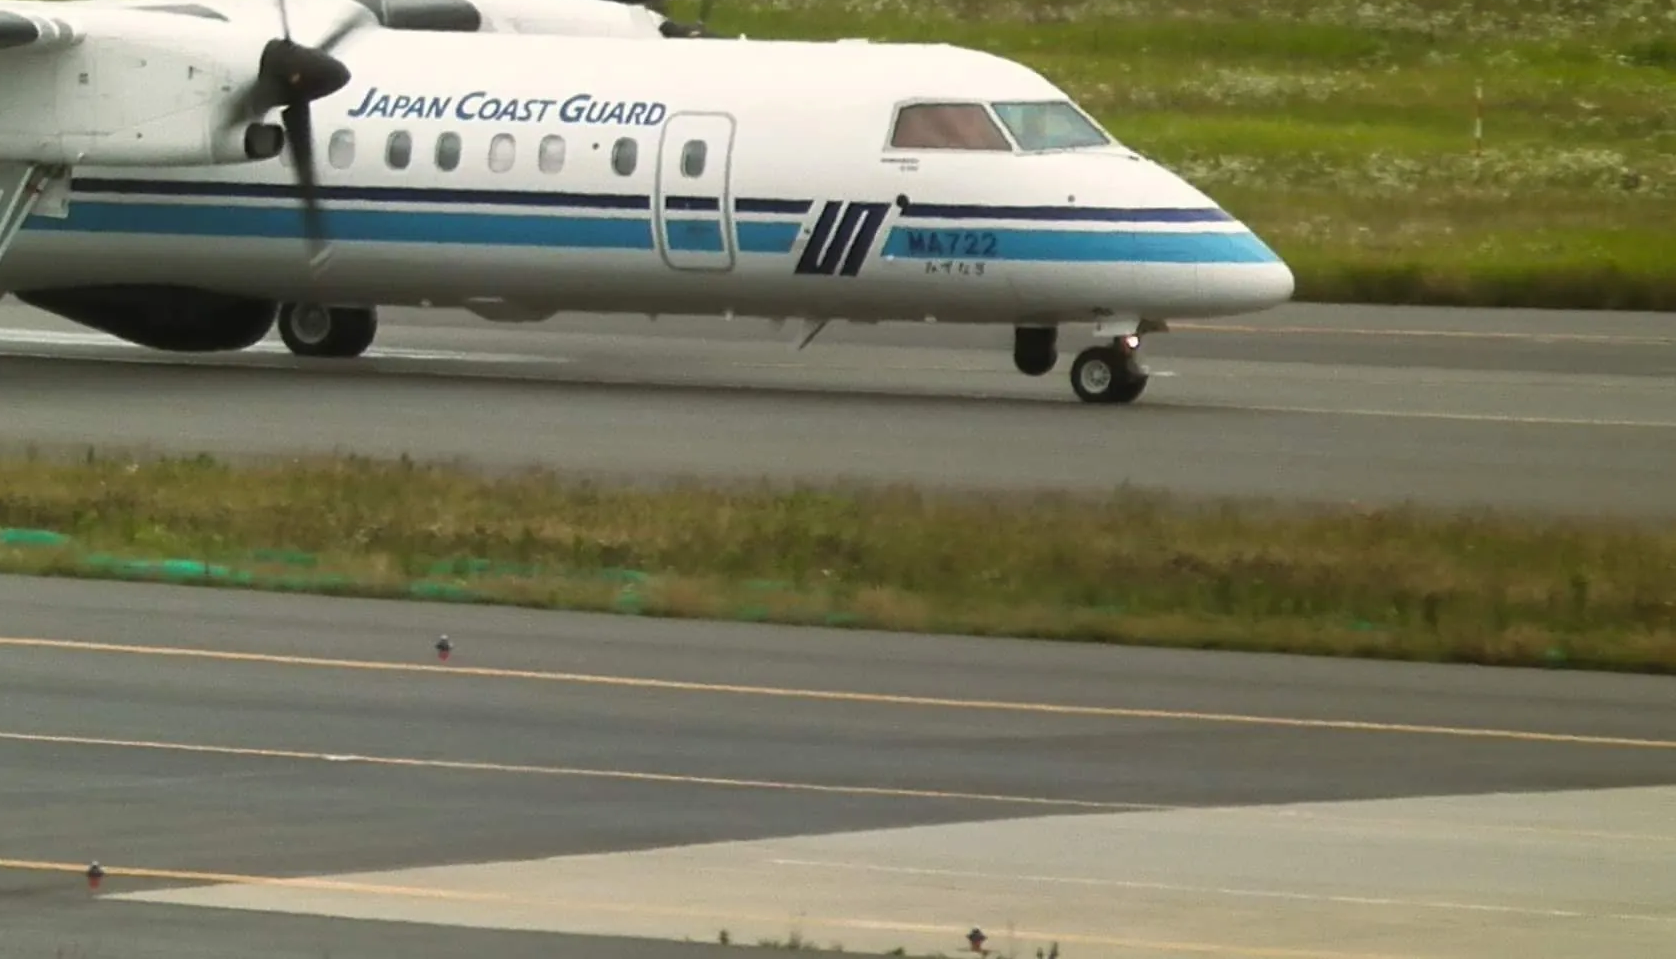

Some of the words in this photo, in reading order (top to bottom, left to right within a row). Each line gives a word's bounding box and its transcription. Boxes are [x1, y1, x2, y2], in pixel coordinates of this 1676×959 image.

[347, 87, 452, 119] JAPAN
[456, 91, 556, 123] COAST
[559, 94, 667, 126] GUARD
[907, 230, 998, 256] MA722
